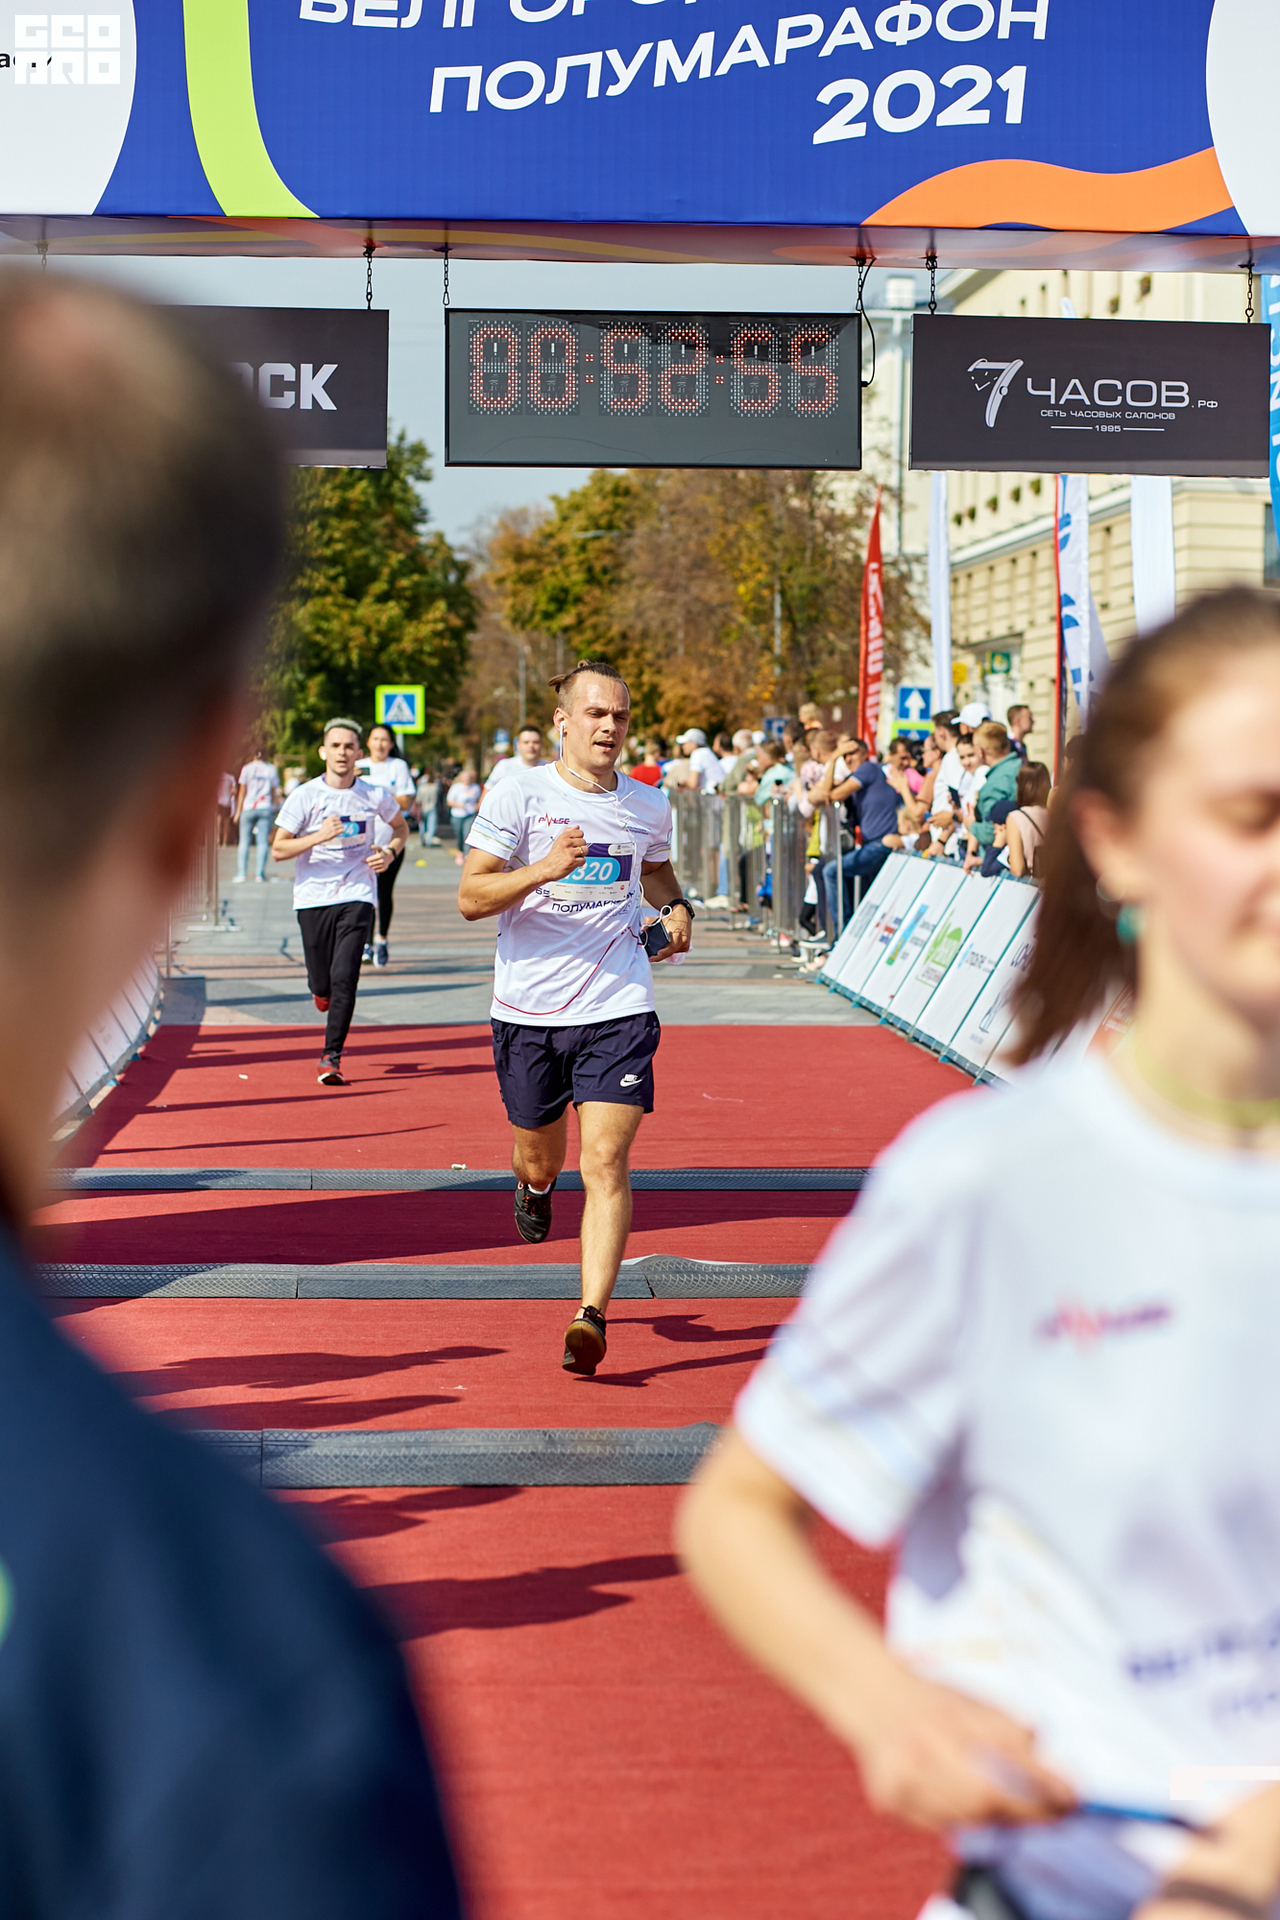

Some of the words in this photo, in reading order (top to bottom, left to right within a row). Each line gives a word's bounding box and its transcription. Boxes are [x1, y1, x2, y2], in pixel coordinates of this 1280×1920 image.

[430, 0, 1050, 113] ПОЛУМАРАФОН
[812, 65, 1027, 145] 2021
[967, 358, 1024, 428] 7
[1040, 409, 1067, 418] СЕТЬ
[1070, 411, 1122, 419] ЧАСОВЫХ
[1125, 411, 1176, 420] САЛОНОВ
[1095, 424, 1122, 432] 1995
